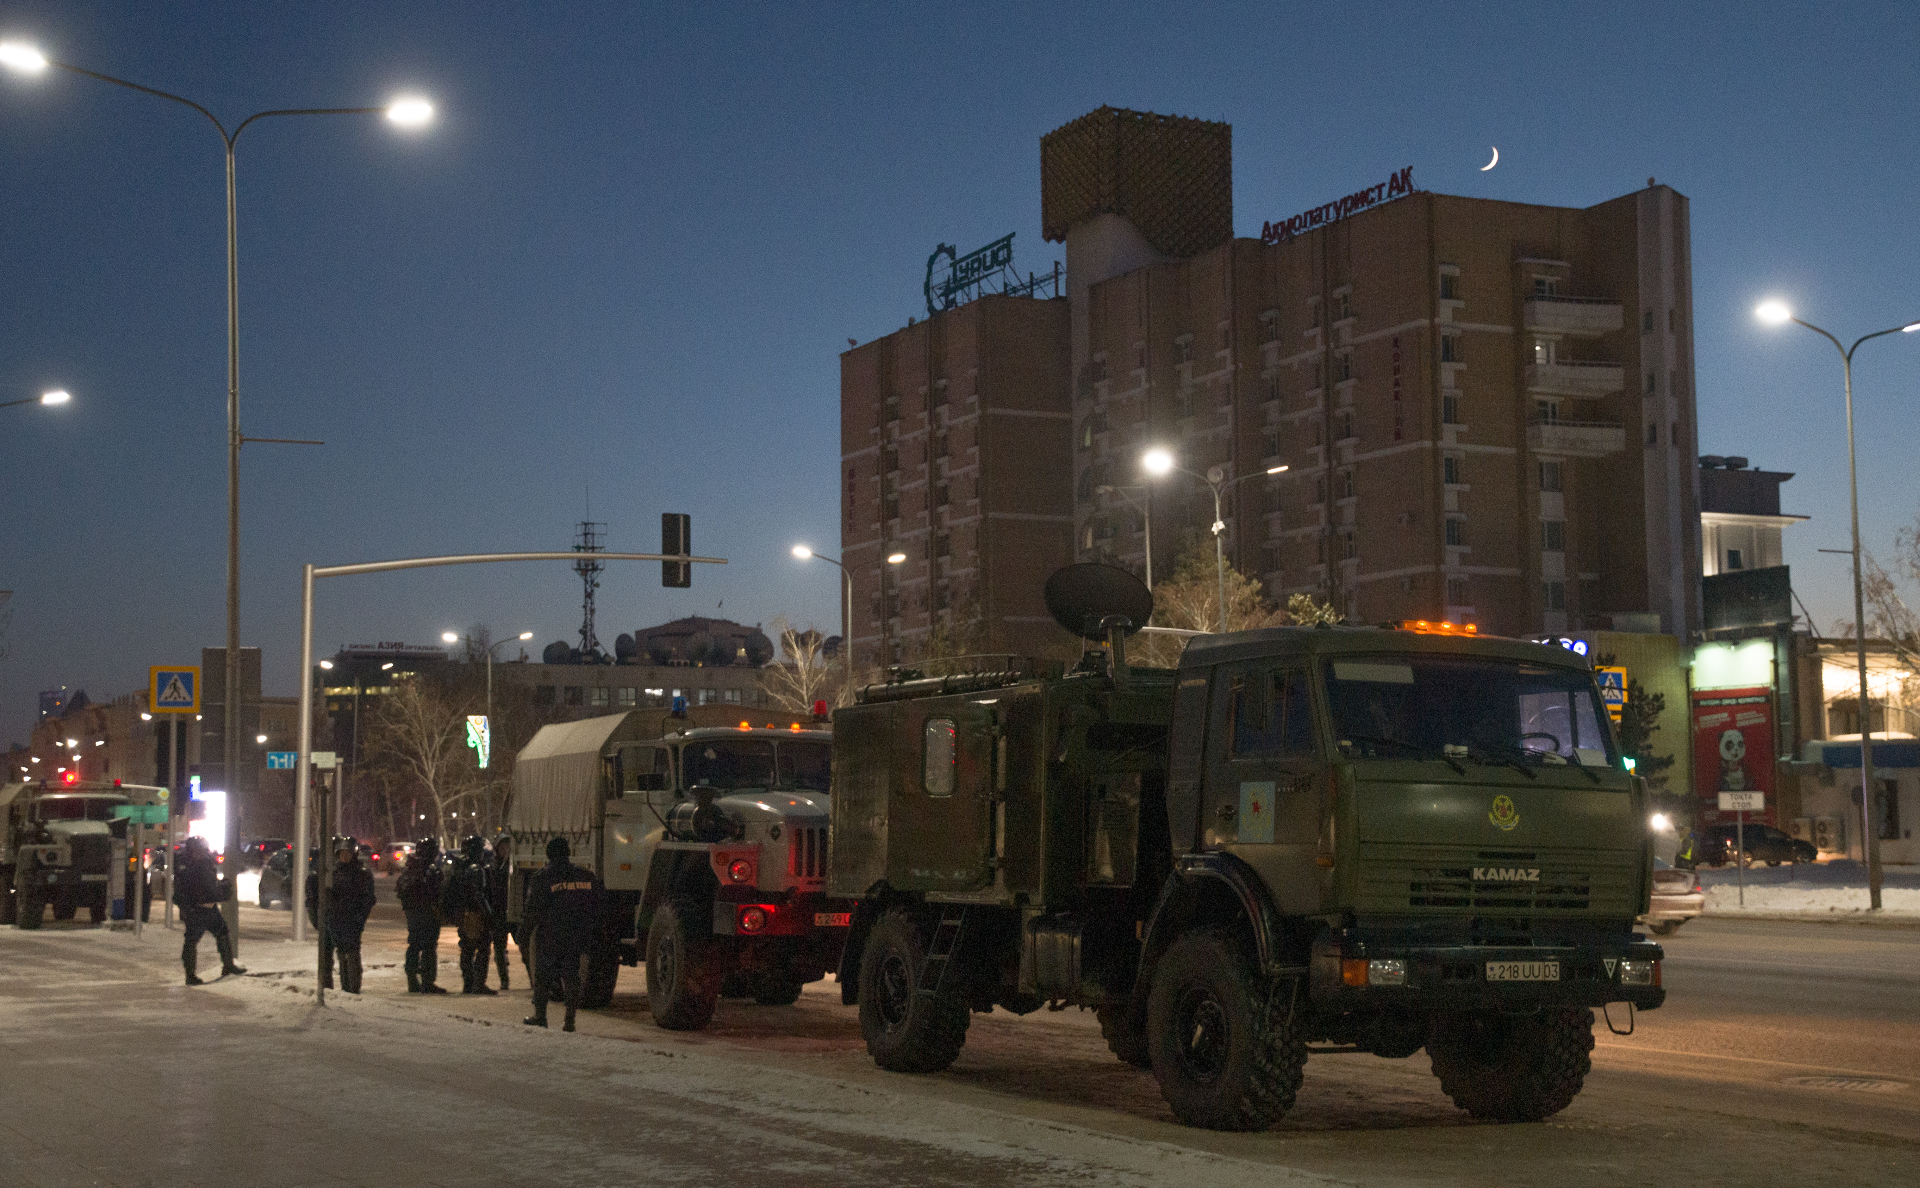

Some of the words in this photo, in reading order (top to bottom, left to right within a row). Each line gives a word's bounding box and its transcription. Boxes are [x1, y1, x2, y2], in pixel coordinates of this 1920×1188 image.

[377, 641, 404, 650] АЗИЯ
[1472, 867, 1540, 881] KAMAZ
[825, 914, 842, 925] 249
[1498, 964, 1520, 979] 218
[1522, 964, 1541, 979] UU
[1543, 964, 1559, 979] 03
